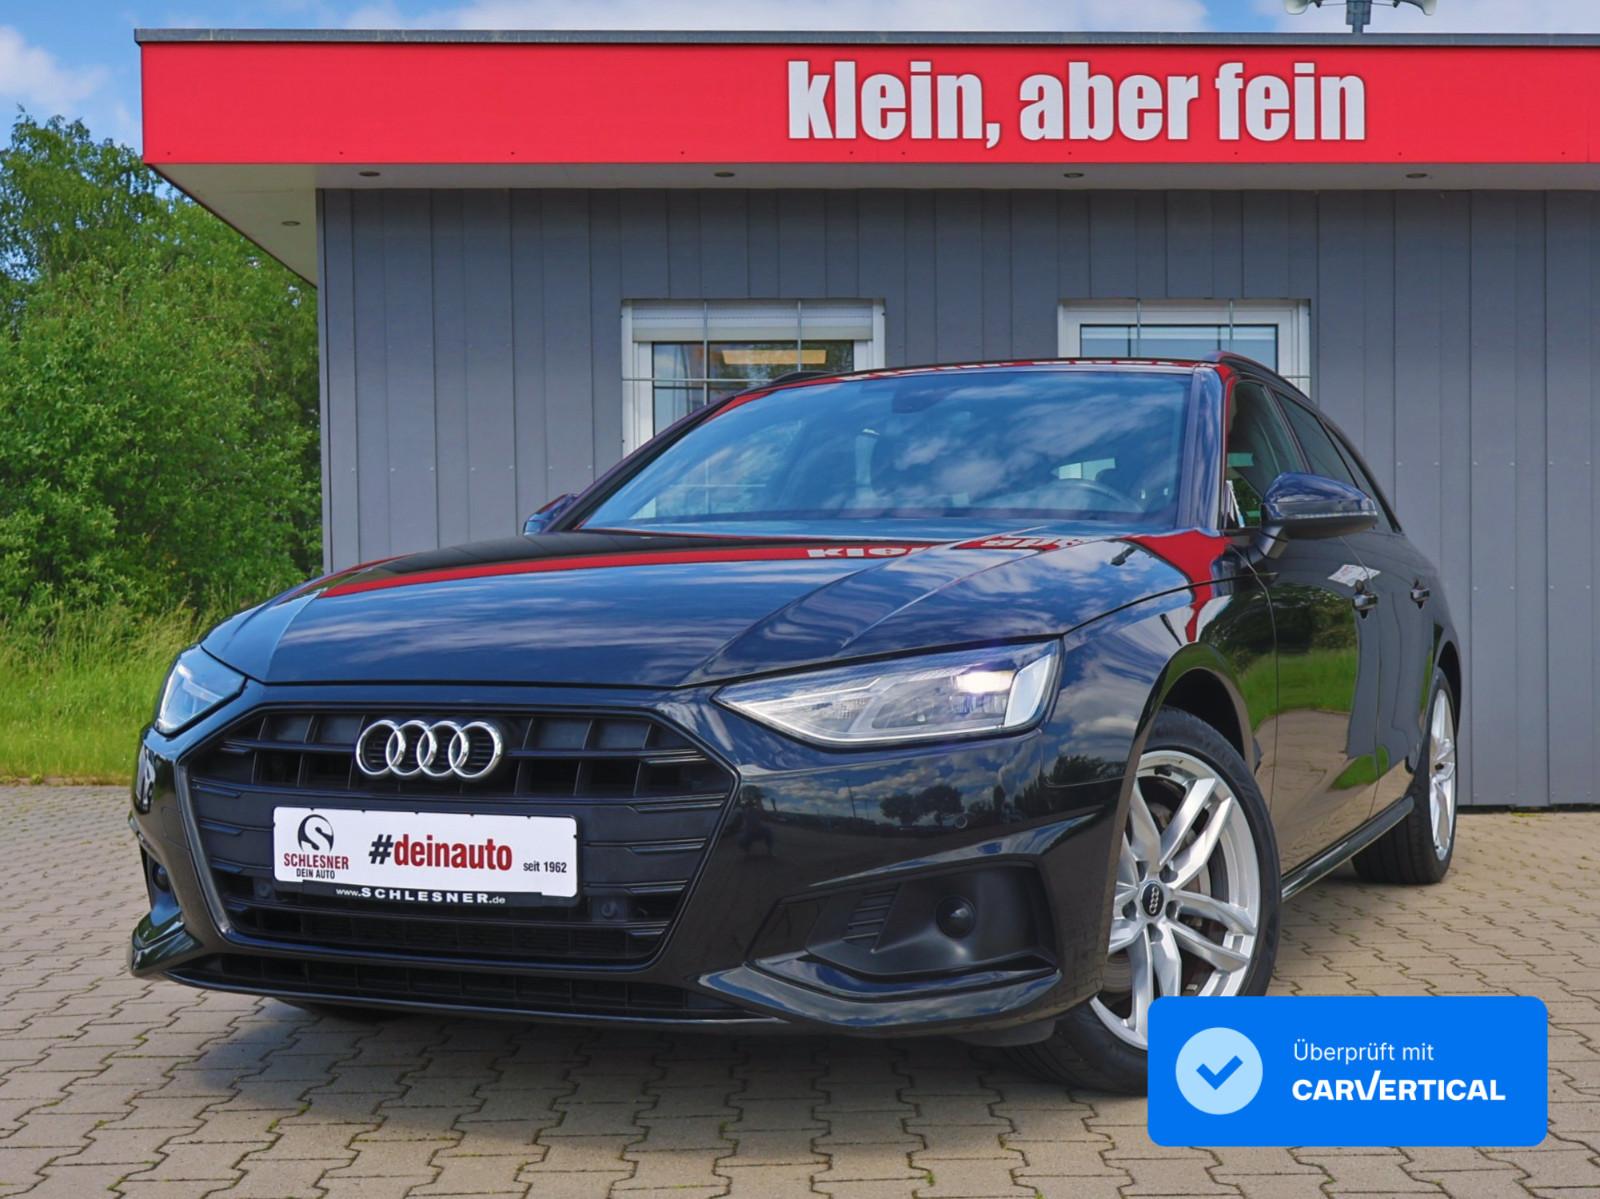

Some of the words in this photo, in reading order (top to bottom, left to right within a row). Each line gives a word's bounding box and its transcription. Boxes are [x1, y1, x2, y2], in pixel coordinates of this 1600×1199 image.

[787, 60, 1001, 149] klein,
[1019, 61, 1199, 141] aber
[1215, 62, 1366, 141] fein
[283, 852, 349, 870] SCHLESNER
[368, 833, 512, 871] #deinauto
[296, 868, 314, 878] DEIN
[315, 869, 336, 880] AUTO
[523, 861, 540, 872] seit
[544, 861, 568, 873] 1962
[336, 887, 506, 905] www.SCHLESNER.de
